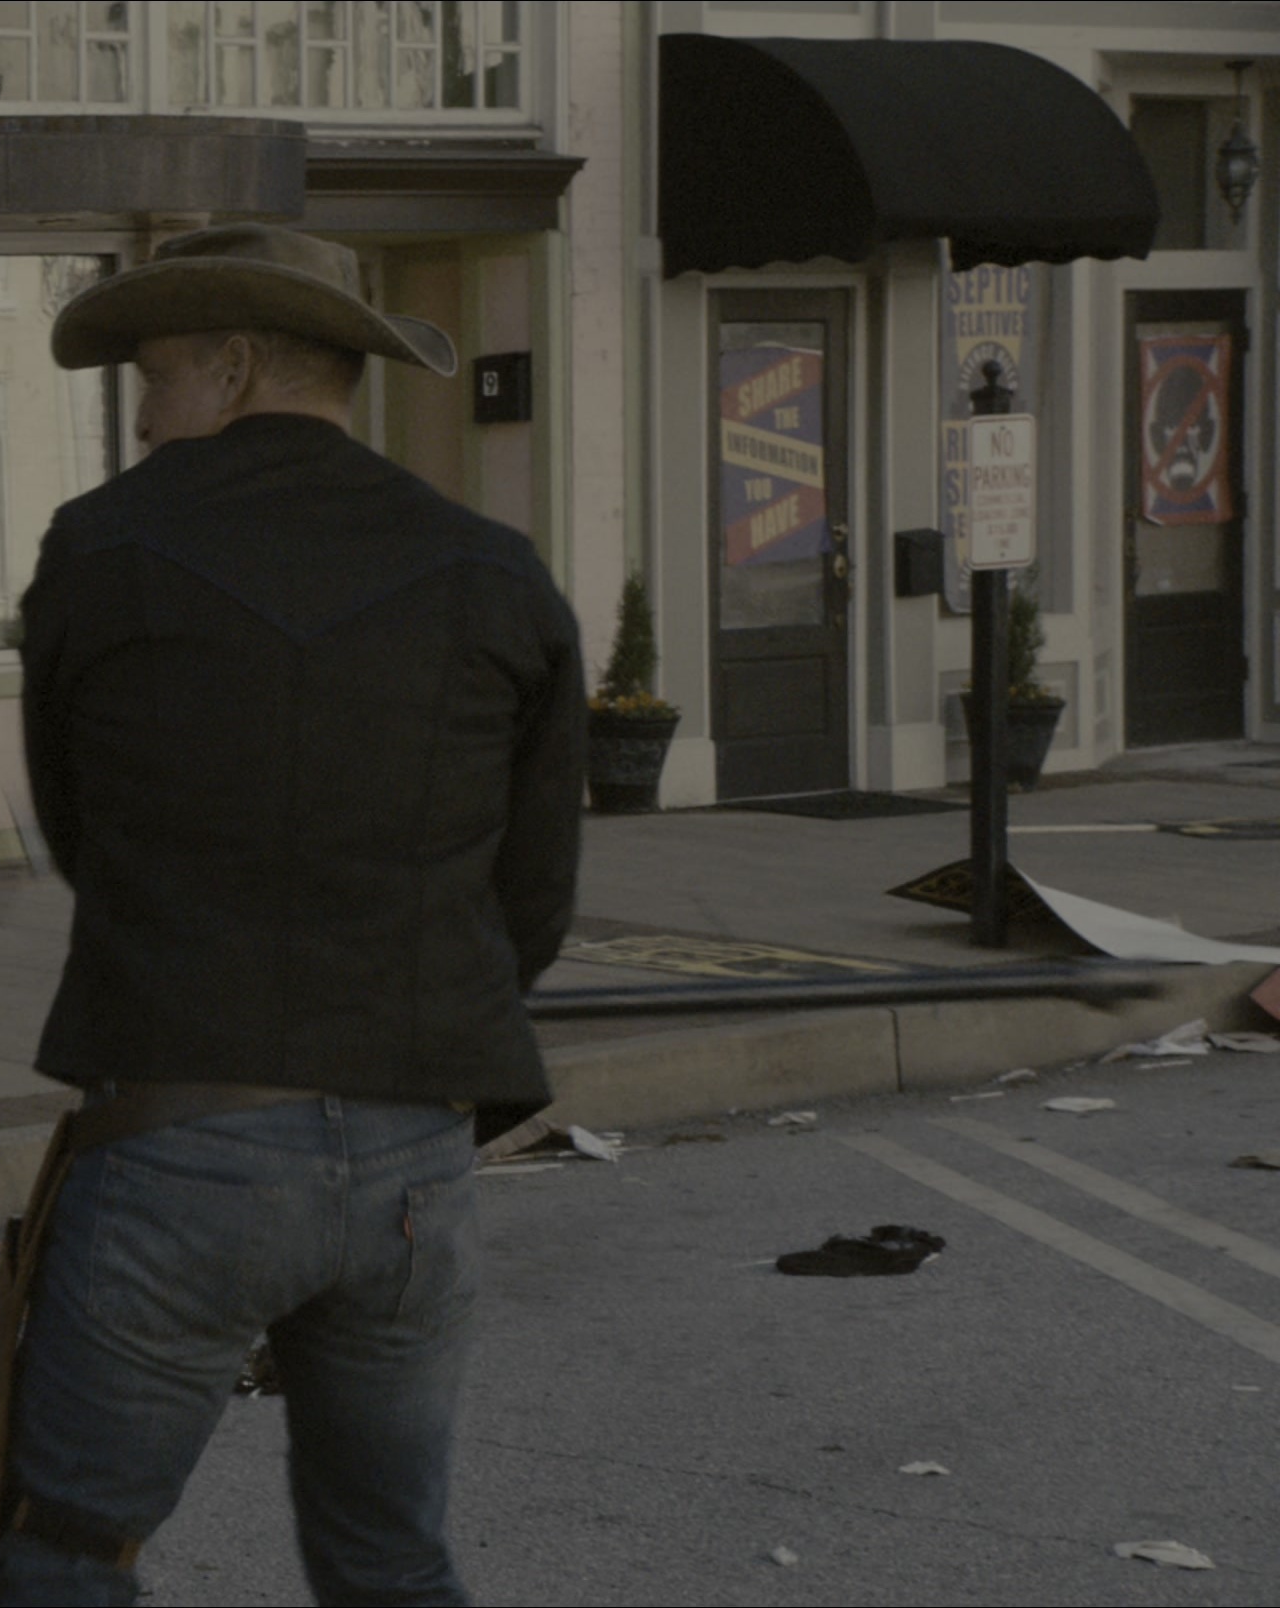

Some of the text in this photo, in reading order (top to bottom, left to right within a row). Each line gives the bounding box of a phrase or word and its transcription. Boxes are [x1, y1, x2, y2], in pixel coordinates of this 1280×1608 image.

[948, 266, 1030, 304] SEPTIC
[738, 355, 804, 419] SHARE
[773, 405, 800, 430] THE
[726, 430, 819, 477] INFORMATION
[990, 429, 1015, 458] NO
[744, 477, 773, 503] YOU
[972, 463, 1031, 492] PARKING
[750, 493, 800, 550] HAVE
